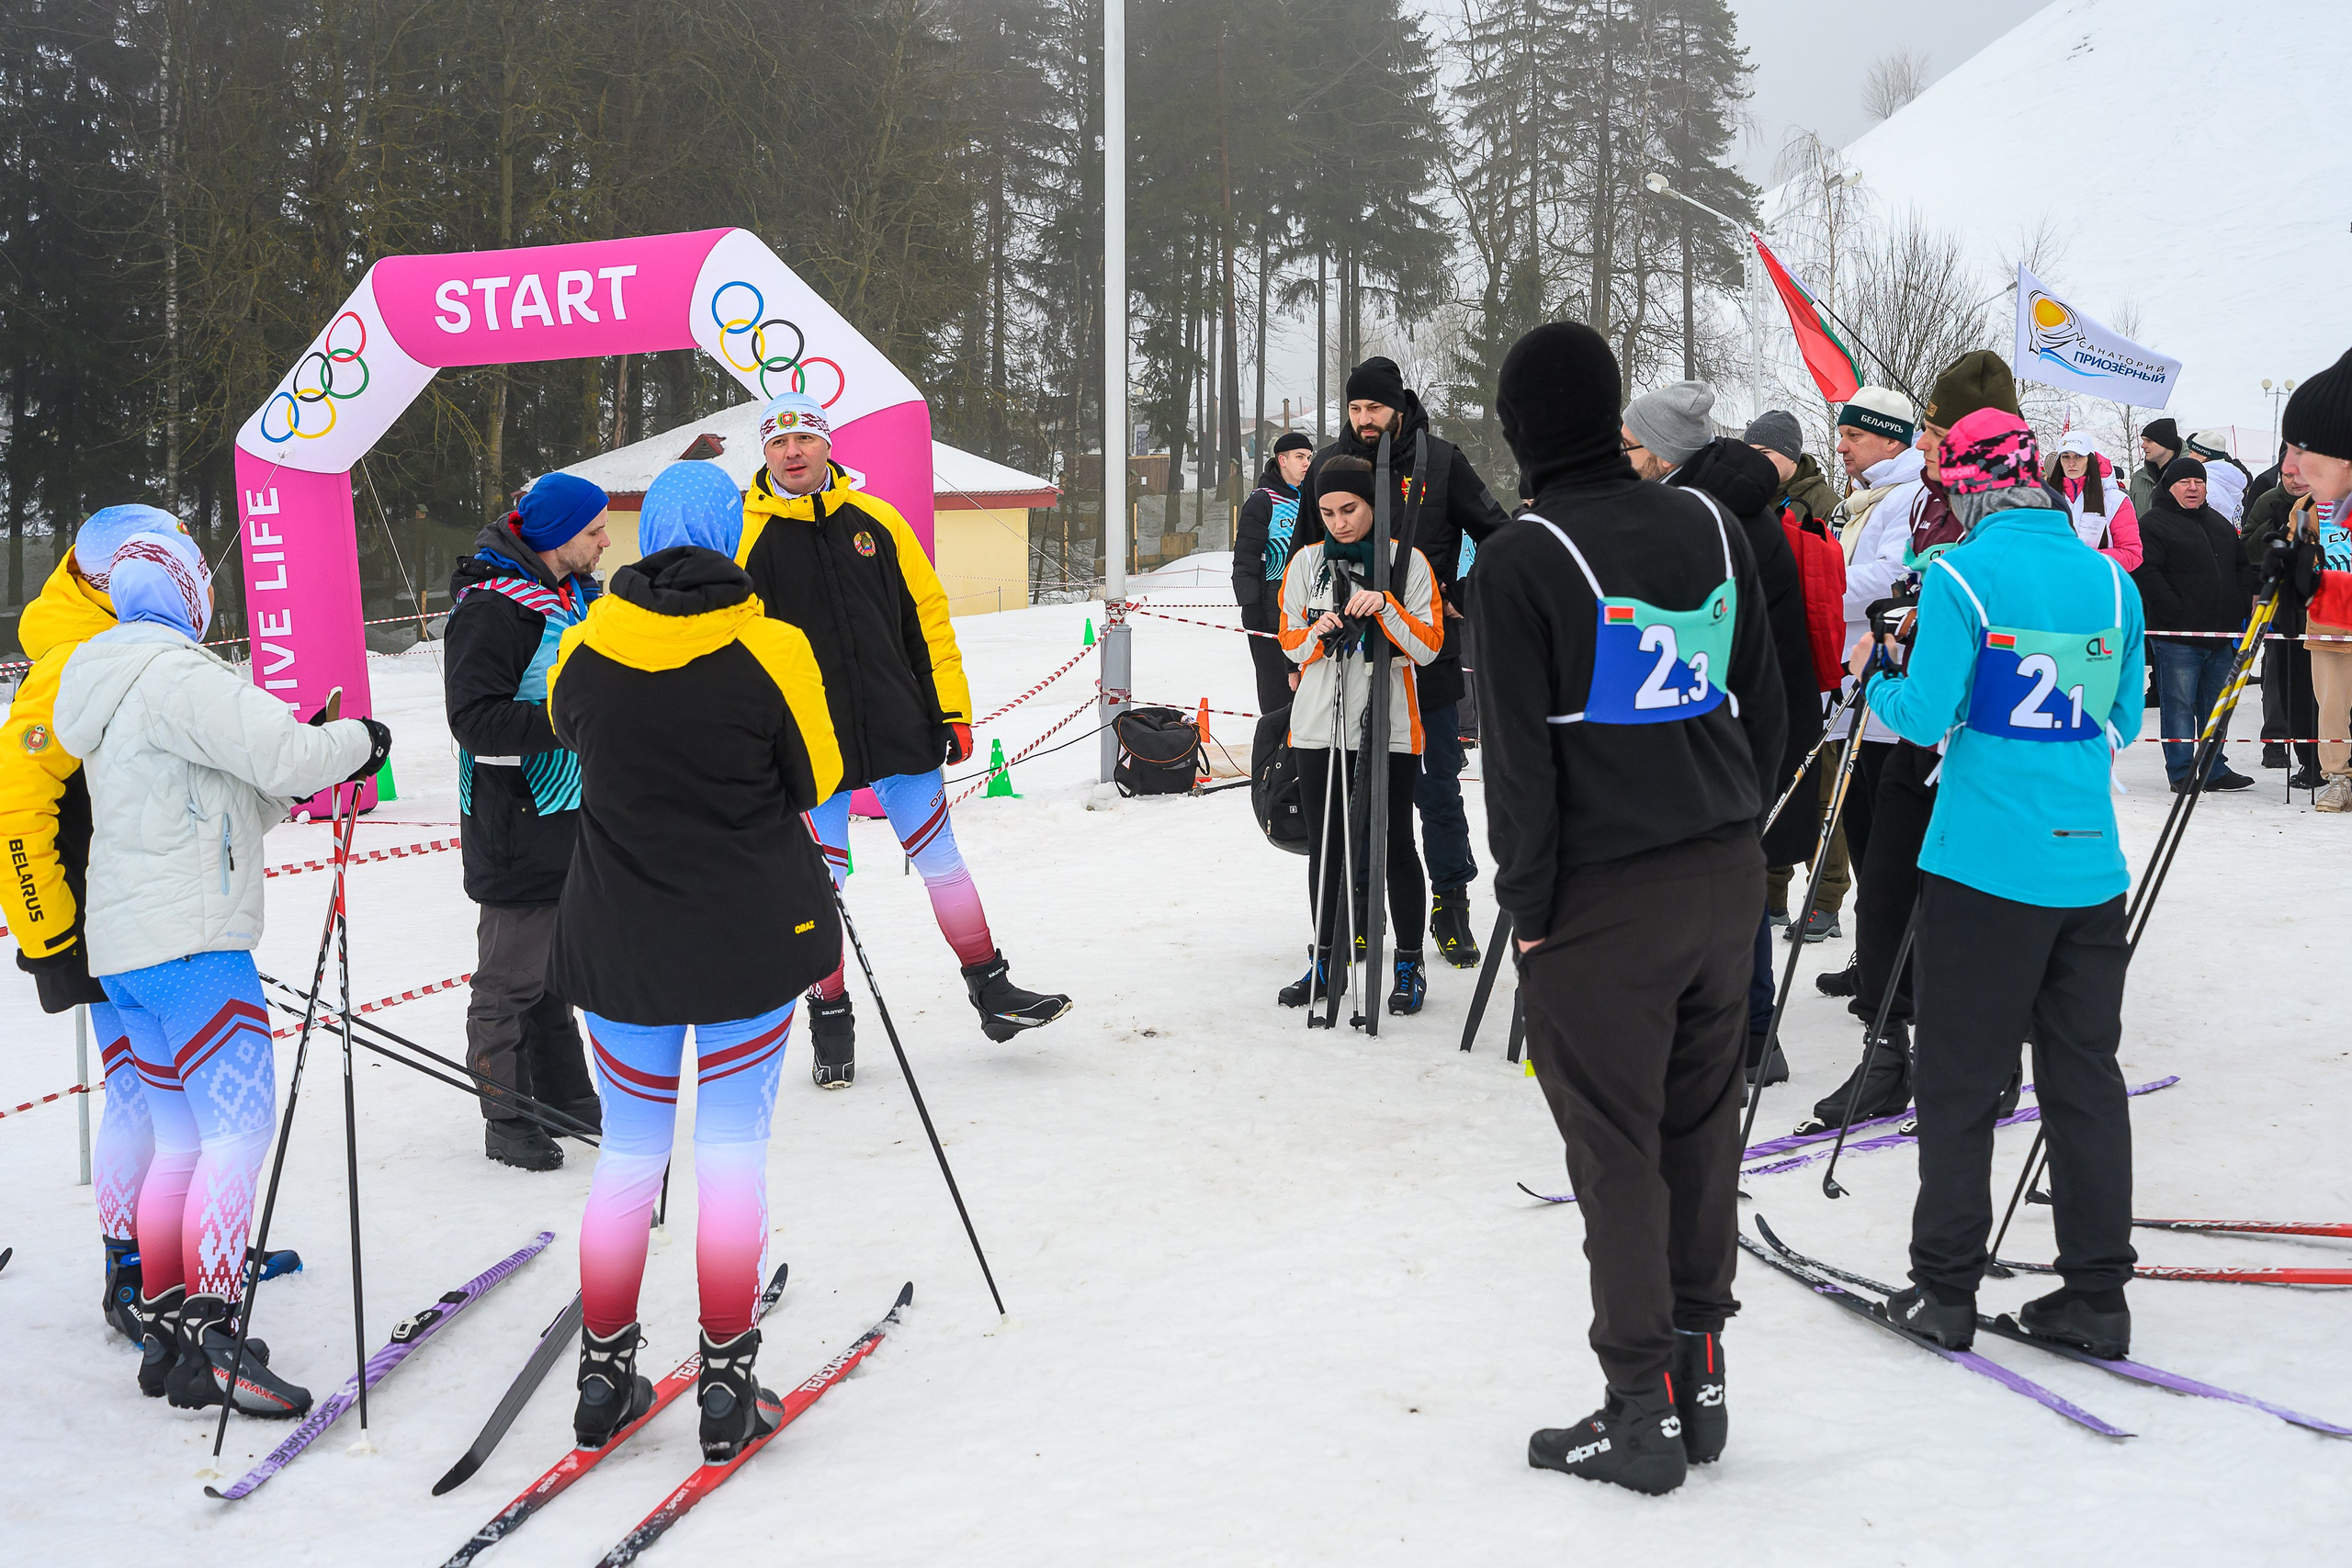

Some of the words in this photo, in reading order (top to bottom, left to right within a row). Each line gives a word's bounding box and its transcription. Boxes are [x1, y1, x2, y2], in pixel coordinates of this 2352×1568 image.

[435, 265, 638, 333] START
[2074, 351, 2166, 384] ПРИОЗЁРНЫЙ
[2078, 340, 2165, 374] САНАТОРИЙ
[1860, 414, 1904, 434] БЕЛАРУСЬ
[246, 487, 288, 591] LIFE
[259, 608, 300, 710] IVE
[1634, 624, 1709, 710] 2.3
[2009, 653, 2085, 729] 2.1
[9, 838, 44, 923] BELARUS
[1566, 1438, 1612, 1465] alpina
